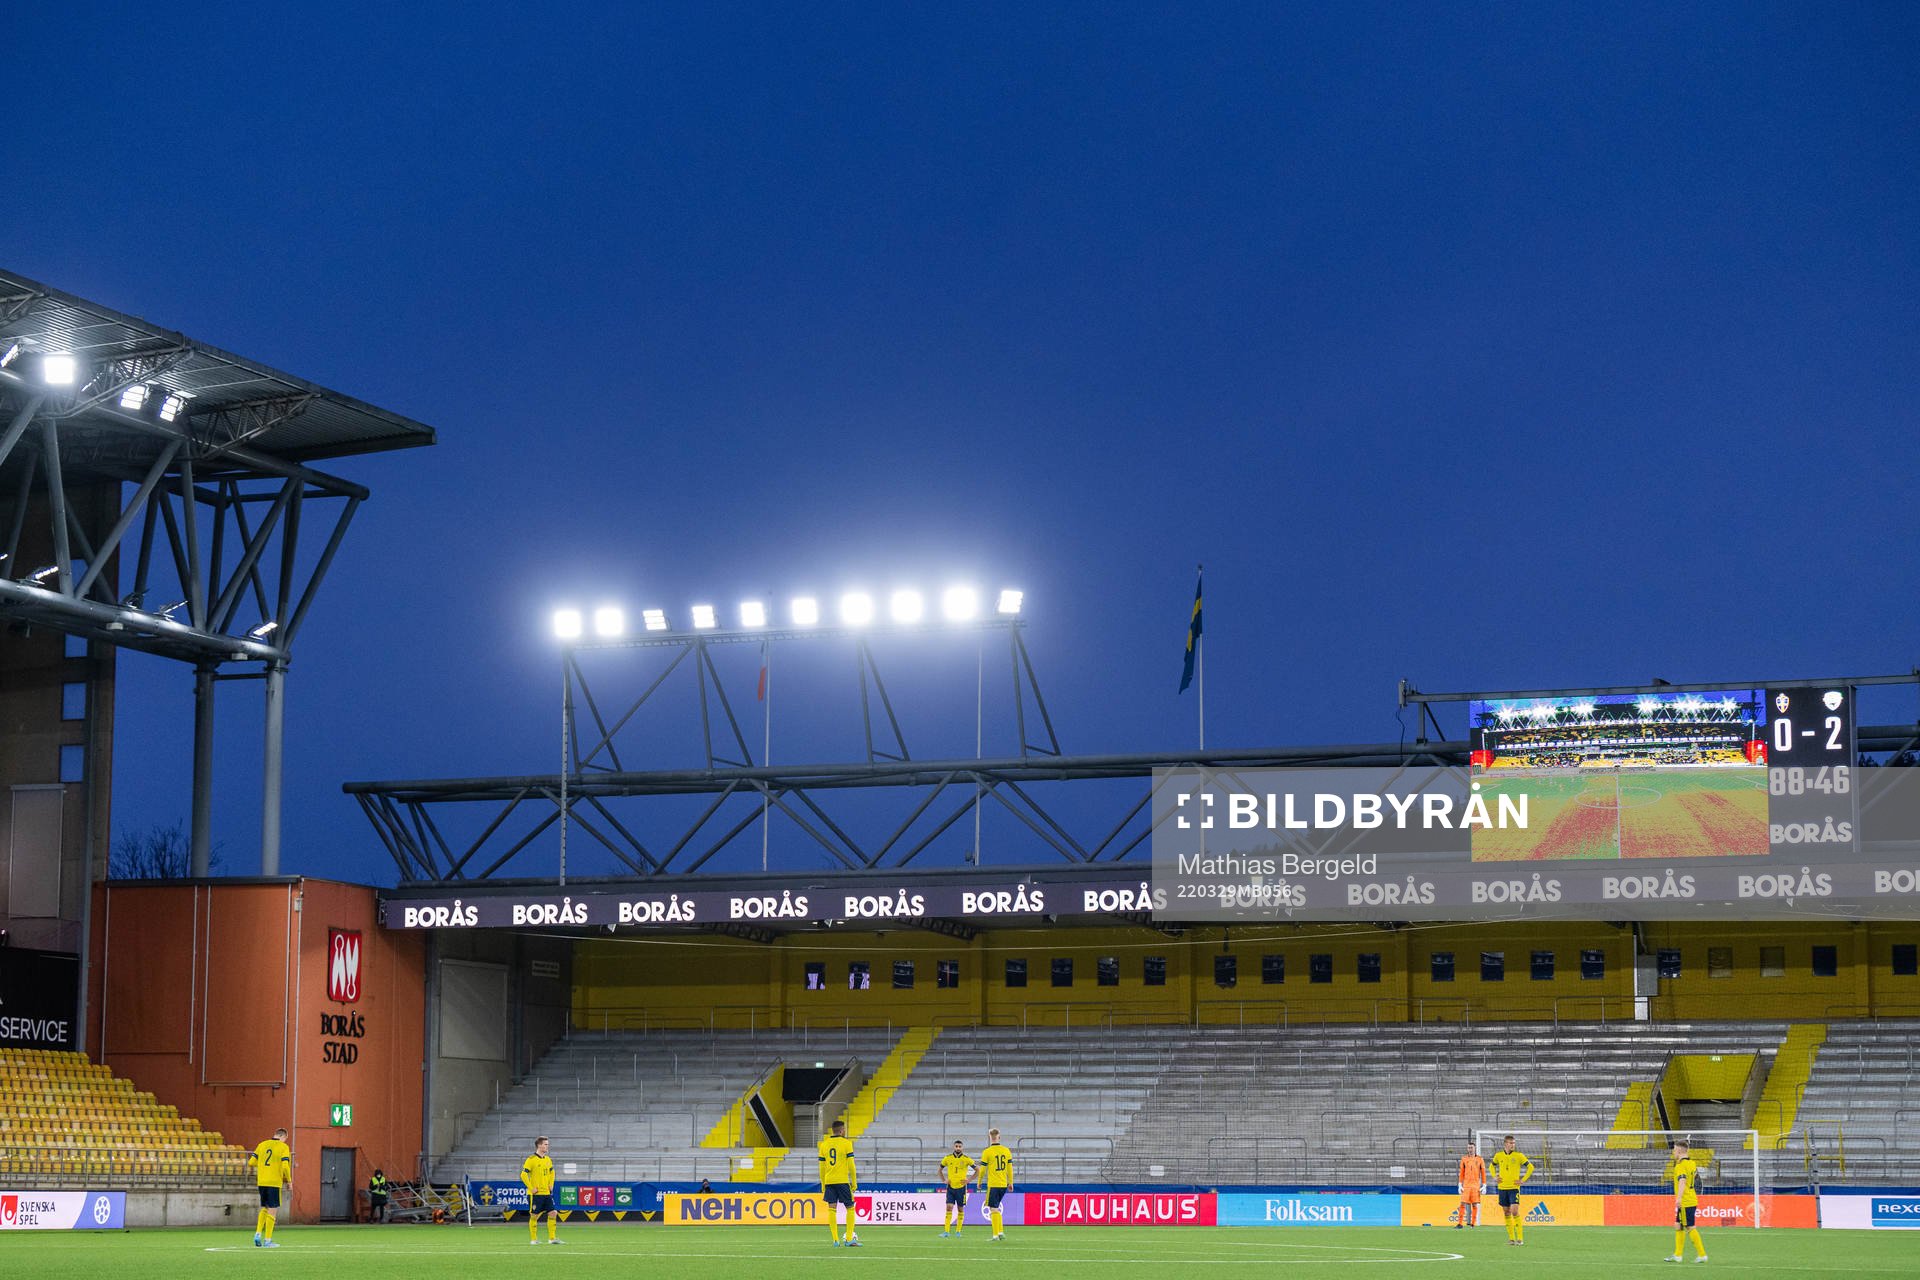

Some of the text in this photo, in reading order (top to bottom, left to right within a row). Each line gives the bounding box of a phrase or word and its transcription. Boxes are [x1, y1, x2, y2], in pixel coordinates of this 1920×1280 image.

[1774, 718, 1792, 752] 0
[1825, 716, 1842, 750] 2
[1769, 816, 1853, 844] BORÅS
[404, 899, 479, 928] BORÅS
[512, 896, 588, 925] BORÅS
[618, 894, 696, 922] BORÅS
[730, 889, 809, 919] BORÅS
[844, 888, 925, 918] BORÅS
[962, 883, 1044, 914] BORÅS
[1083, 881, 1168, 912] BORÅS
[1347, 875, 1436, 906] BORÅS
[1471, 872, 1562, 903] BORÅS
[1602, 869, 1696, 899] BORÅS
[1738, 866, 1833, 898] BORÅS
[1875, 869, 1920, 893] BO
[0, 1016, 68, 1043] SERVICE
[320, 1010, 365, 1038] BORÅS
[323, 1041, 358, 1065] STAD
[264, 1148, 273, 1166] 2
[829, 1148, 837, 1166] 9
[994, 1154, 1006, 1171] 16
[20, 1201, 56, 1212] SVENSKA
[876, 1201, 927, 1211] SVENSKA
[1044, 1198, 1197, 1220] BAUHAUS
[1263, 1199, 1353, 1221] Folksam
[1676, 1205, 1744, 1218] edbank
[19, 1214, 39, 1225] SPEL
[875, 1212, 902, 1222] SPEL
[1525, 1214, 1555, 1222] adidas
